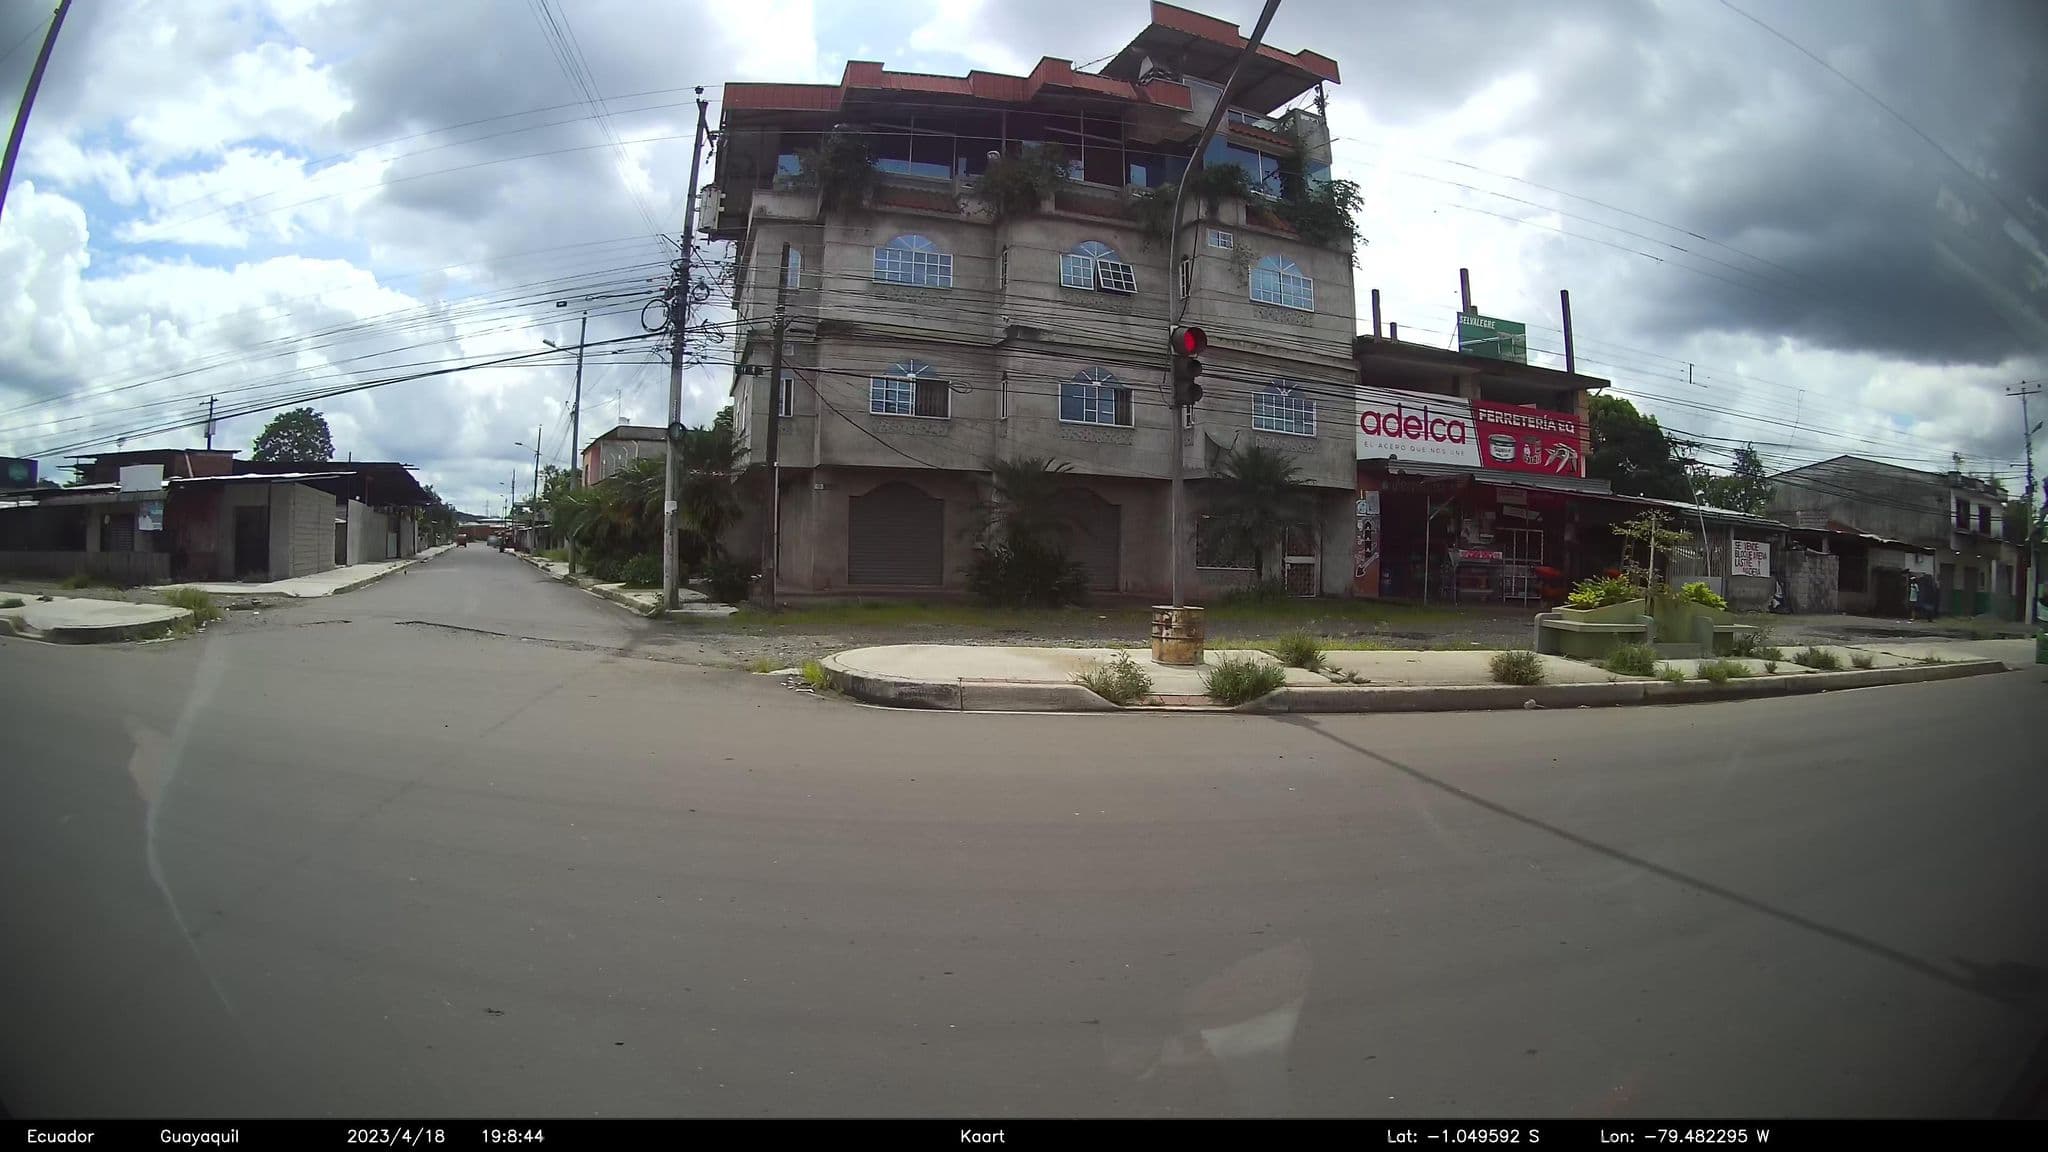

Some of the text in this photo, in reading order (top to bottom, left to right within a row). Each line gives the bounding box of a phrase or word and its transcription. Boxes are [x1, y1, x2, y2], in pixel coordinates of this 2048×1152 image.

[1459, 315, 1496, 330] SELVALEGRE
[1360, 402, 1466, 444] adelca
[1378, 442, 1406, 451] ACERO
[1410, 445, 1426, 453] QUE
